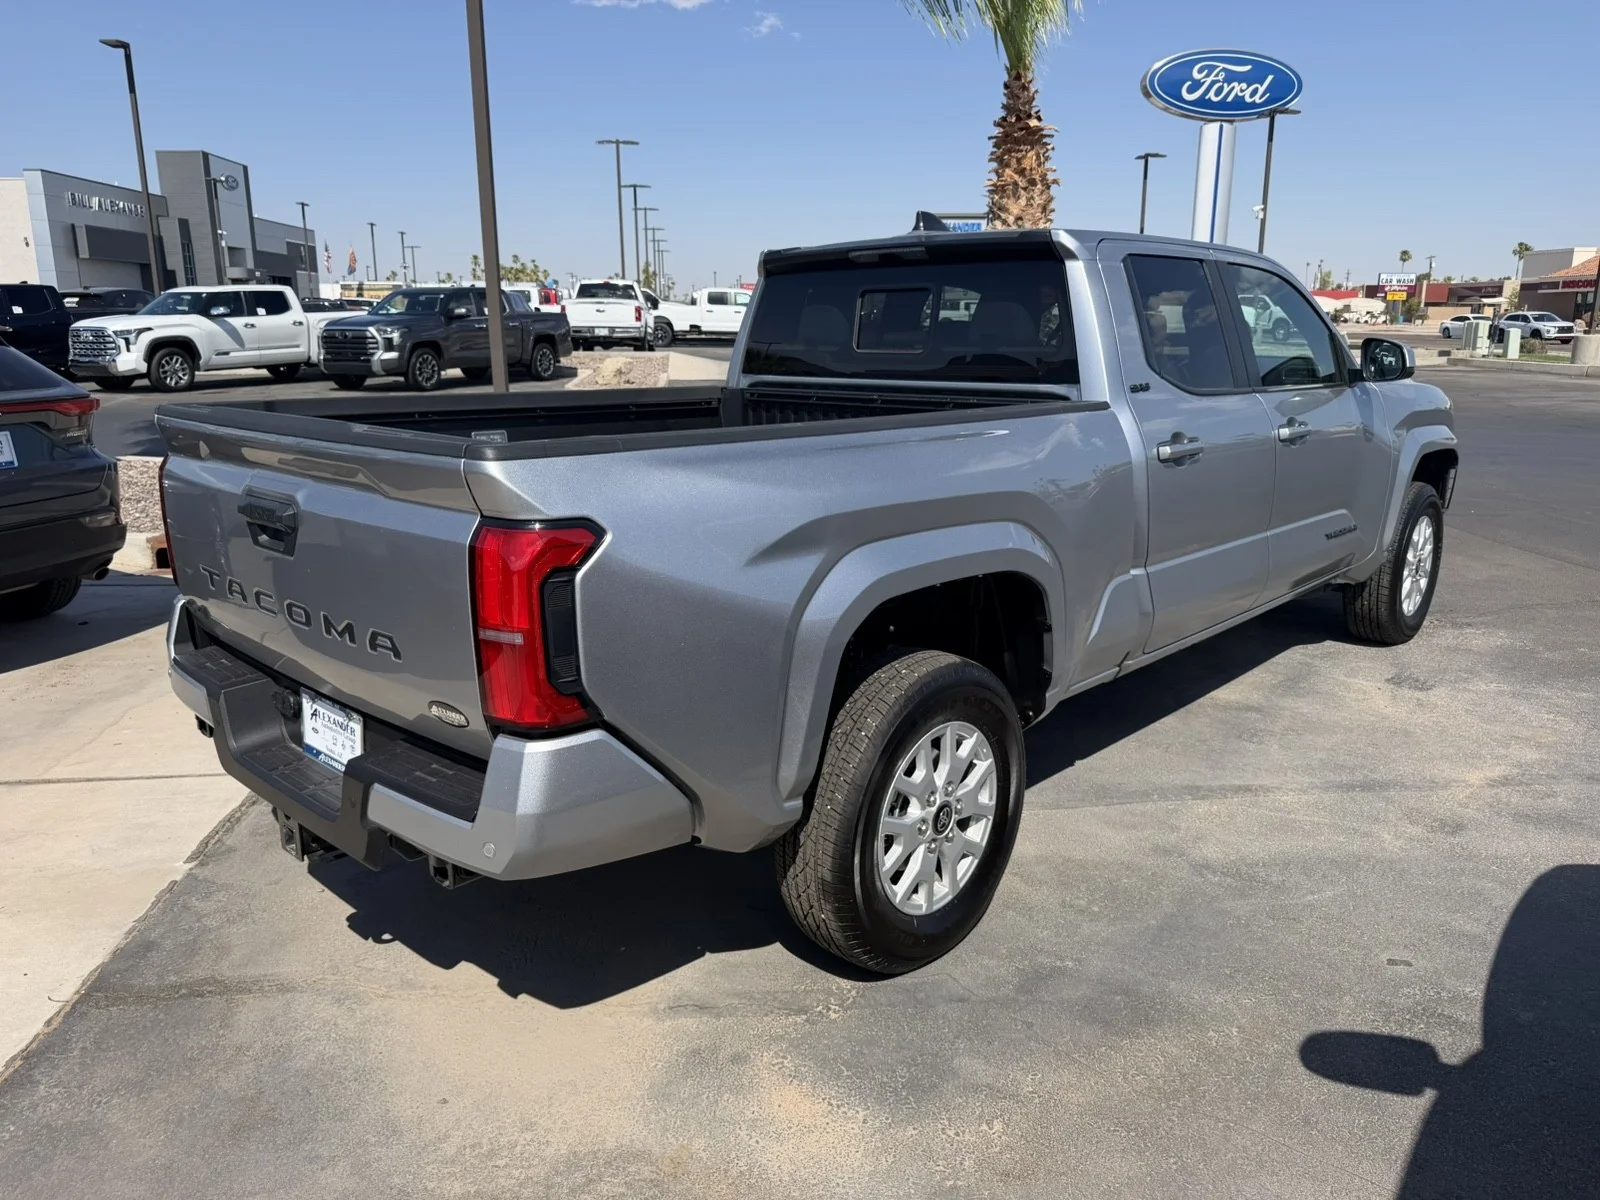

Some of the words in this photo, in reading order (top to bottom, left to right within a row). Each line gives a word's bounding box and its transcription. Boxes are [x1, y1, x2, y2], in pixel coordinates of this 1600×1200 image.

[1181, 61, 1275, 104] Ford
[67, 191, 95, 211] BILL
[96, 196, 146, 218] ALEXANDE
[1561, 279, 1597, 289] DISCOU
[199, 564, 404, 663] TACOMA
[310, 707, 356, 737] ALEXANDER
